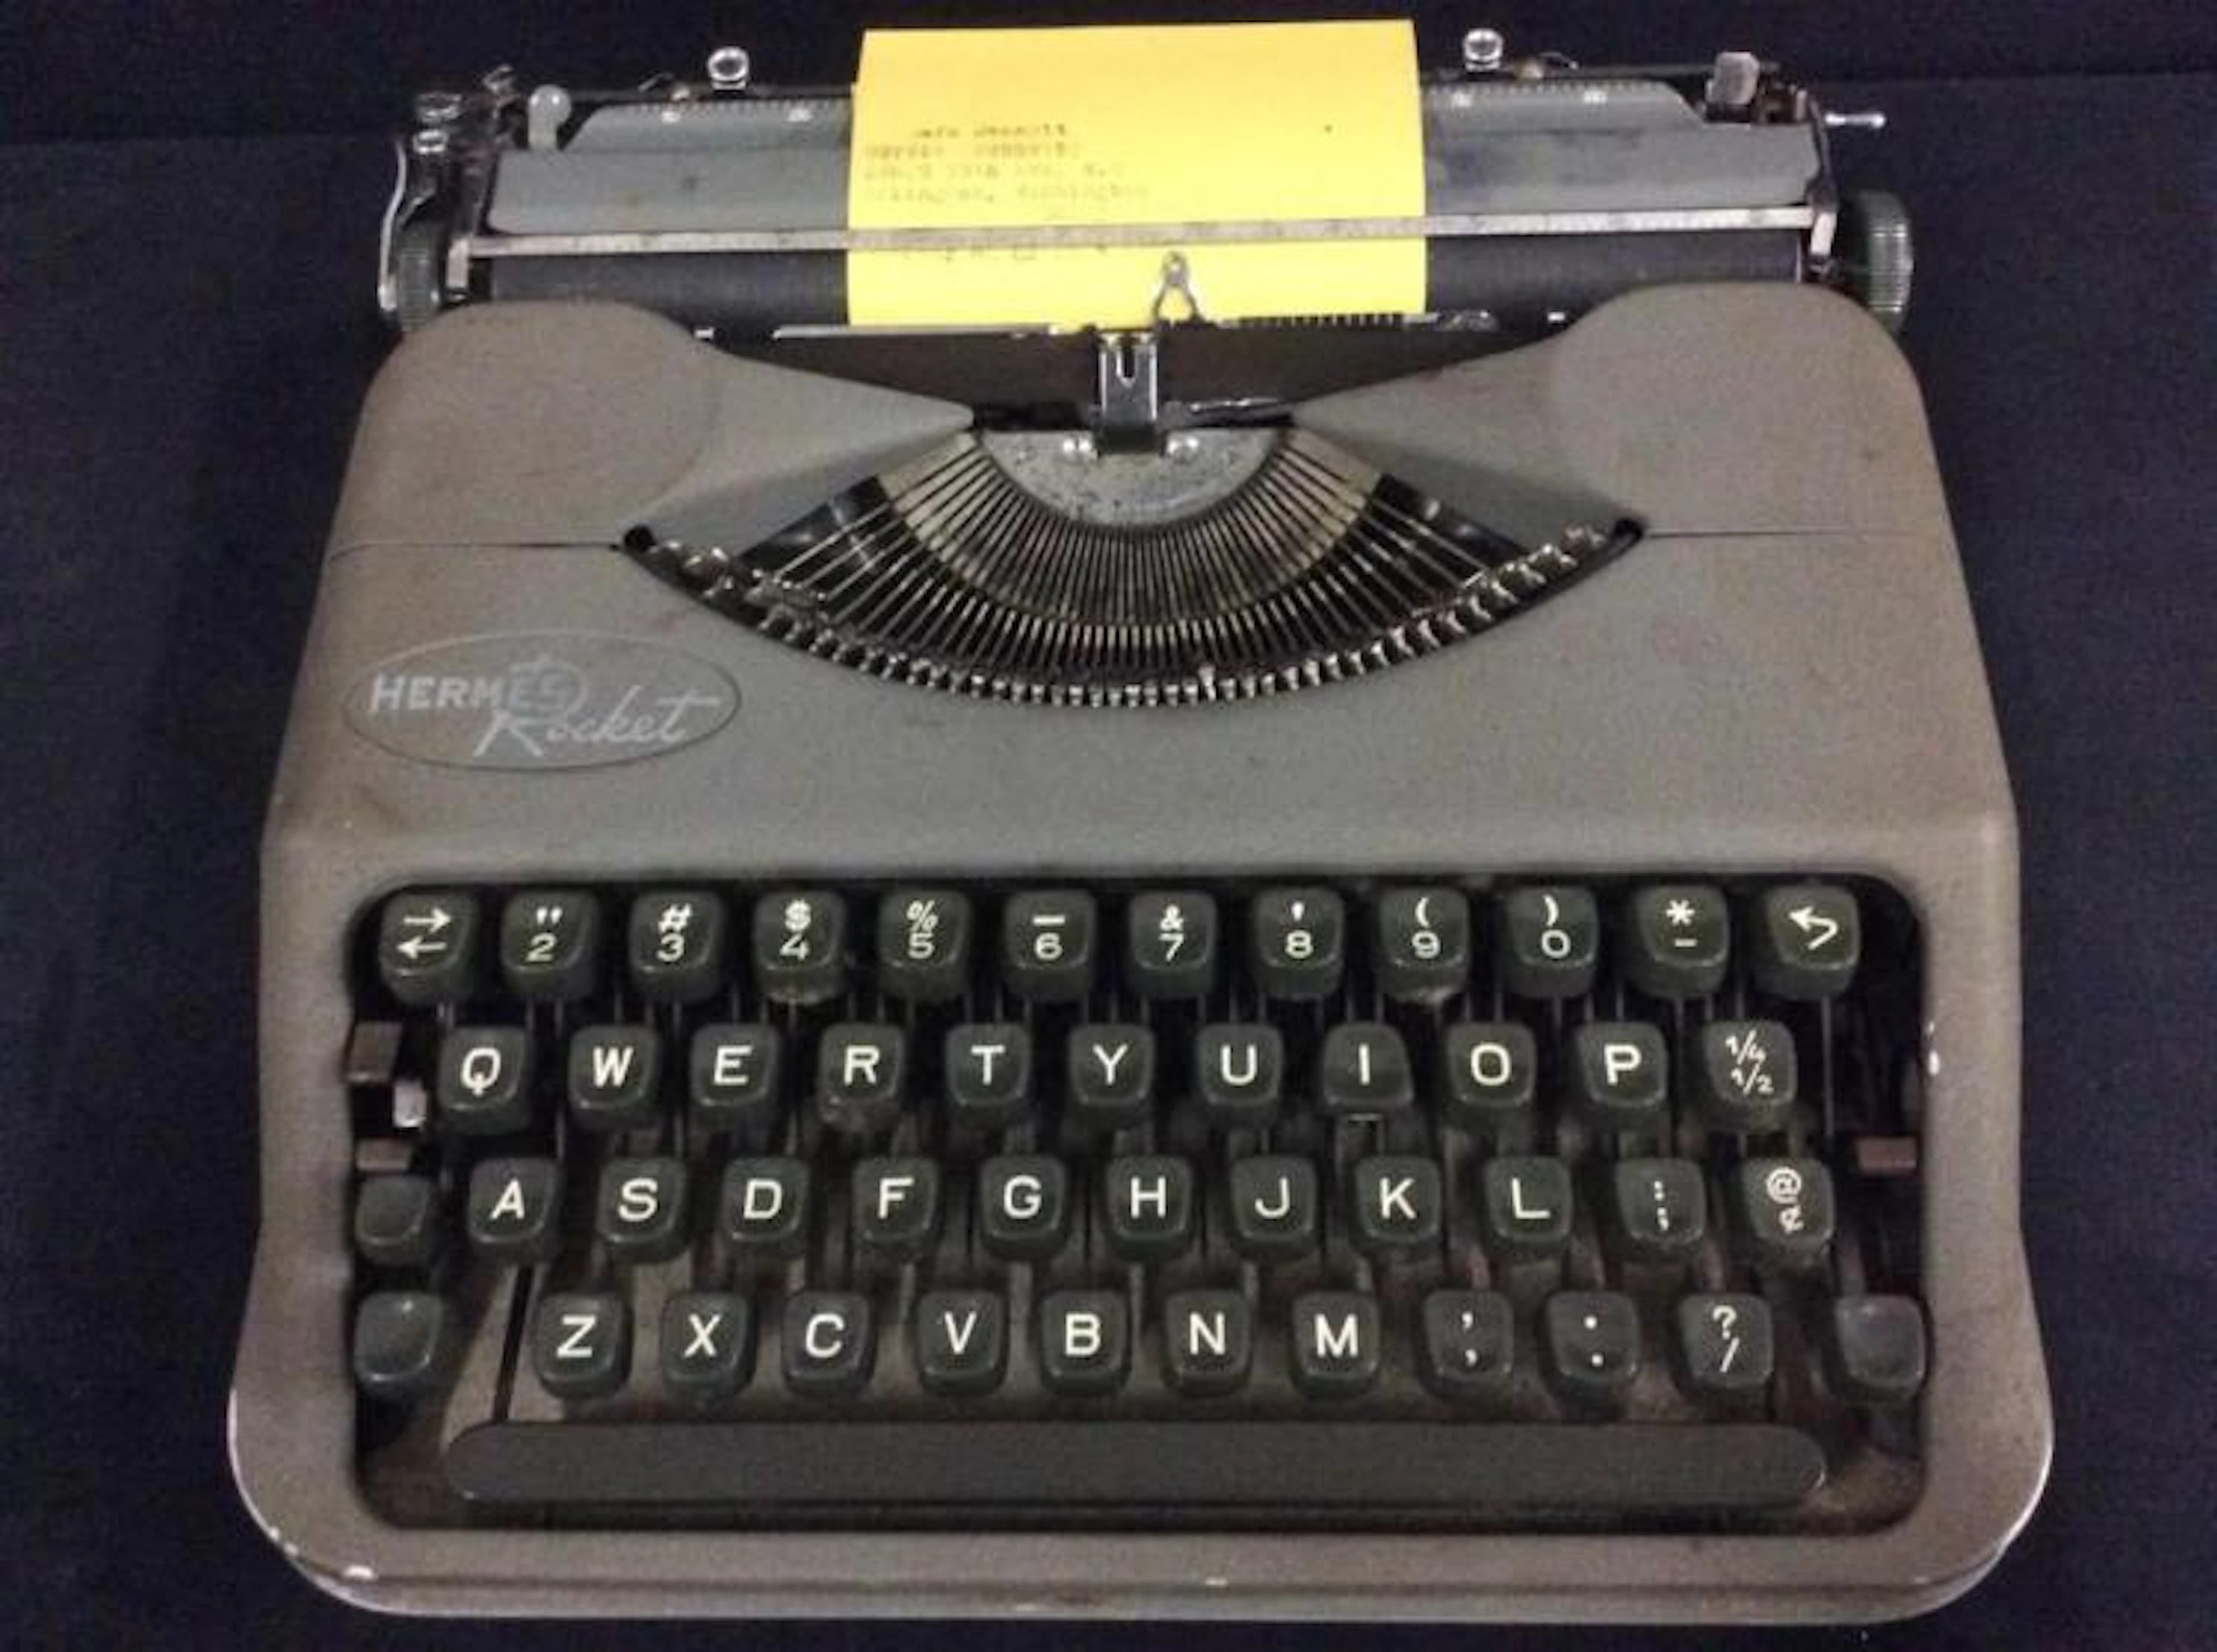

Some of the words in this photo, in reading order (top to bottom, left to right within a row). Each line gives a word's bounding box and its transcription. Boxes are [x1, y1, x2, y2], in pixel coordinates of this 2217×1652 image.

[366, 670, 572, 716] HERMES
[472, 683, 721, 758] Rocket
[656, 902, 693, 934] #
[783, 898, 812, 934] $
[905, 899, 940, 933] %
[1158, 903, 1185, 933] &
[526, 932, 557, 962] 2
[656, 931, 685, 963] 3
[779, 932, 810, 960] 4
[906, 931, 935, 960] 5
[1033, 931, 1063, 960] 6
[1159, 931, 1185, 962] 7
[1284, 929, 1314, 959] 8
[1410, 929, 1441, 959] 9
[459, 1045, 502, 1097] Q
[592, 1045, 635, 1088] W
[712, 1044, 754, 1086] E
[842, 1044, 881, 1086] R
[969, 1043, 1006, 1085] T
[1092, 1043, 1129, 1085] Y
[1219, 1043, 1259, 1086] U
[1357, 1042, 1371, 1085] I
[1469, 1041, 1512, 1087] O
[1602, 1042, 1643, 1086] P
[489, 1178, 526, 1220] A
[617, 1176, 659, 1223] S
[742, 1177, 783, 1220] D
[878, 1175, 915, 1220] F
[1002, 1173, 1043, 1220] G
[1129, 1175, 1167, 1219] H
[1253, 1176, 1291, 1219] J
[1378, 1176, 1416, 1220] K
[1510, 1176, 1551, 1220] L
[1764, 1165, 1804, 1205] @
[555, 1313, 598, 1359] Z
[683, 1312, 722, 1358] X
[804, 1311, 846, 1359] C
[943, 1310, 978, 1355] V
[1064, 1311, 1102, 1357] B
[1188, 1311, 1227, 1356] N
[1313, 1312, 1360, 1358] M
[1711, 1304, 1738, 1341] ?
